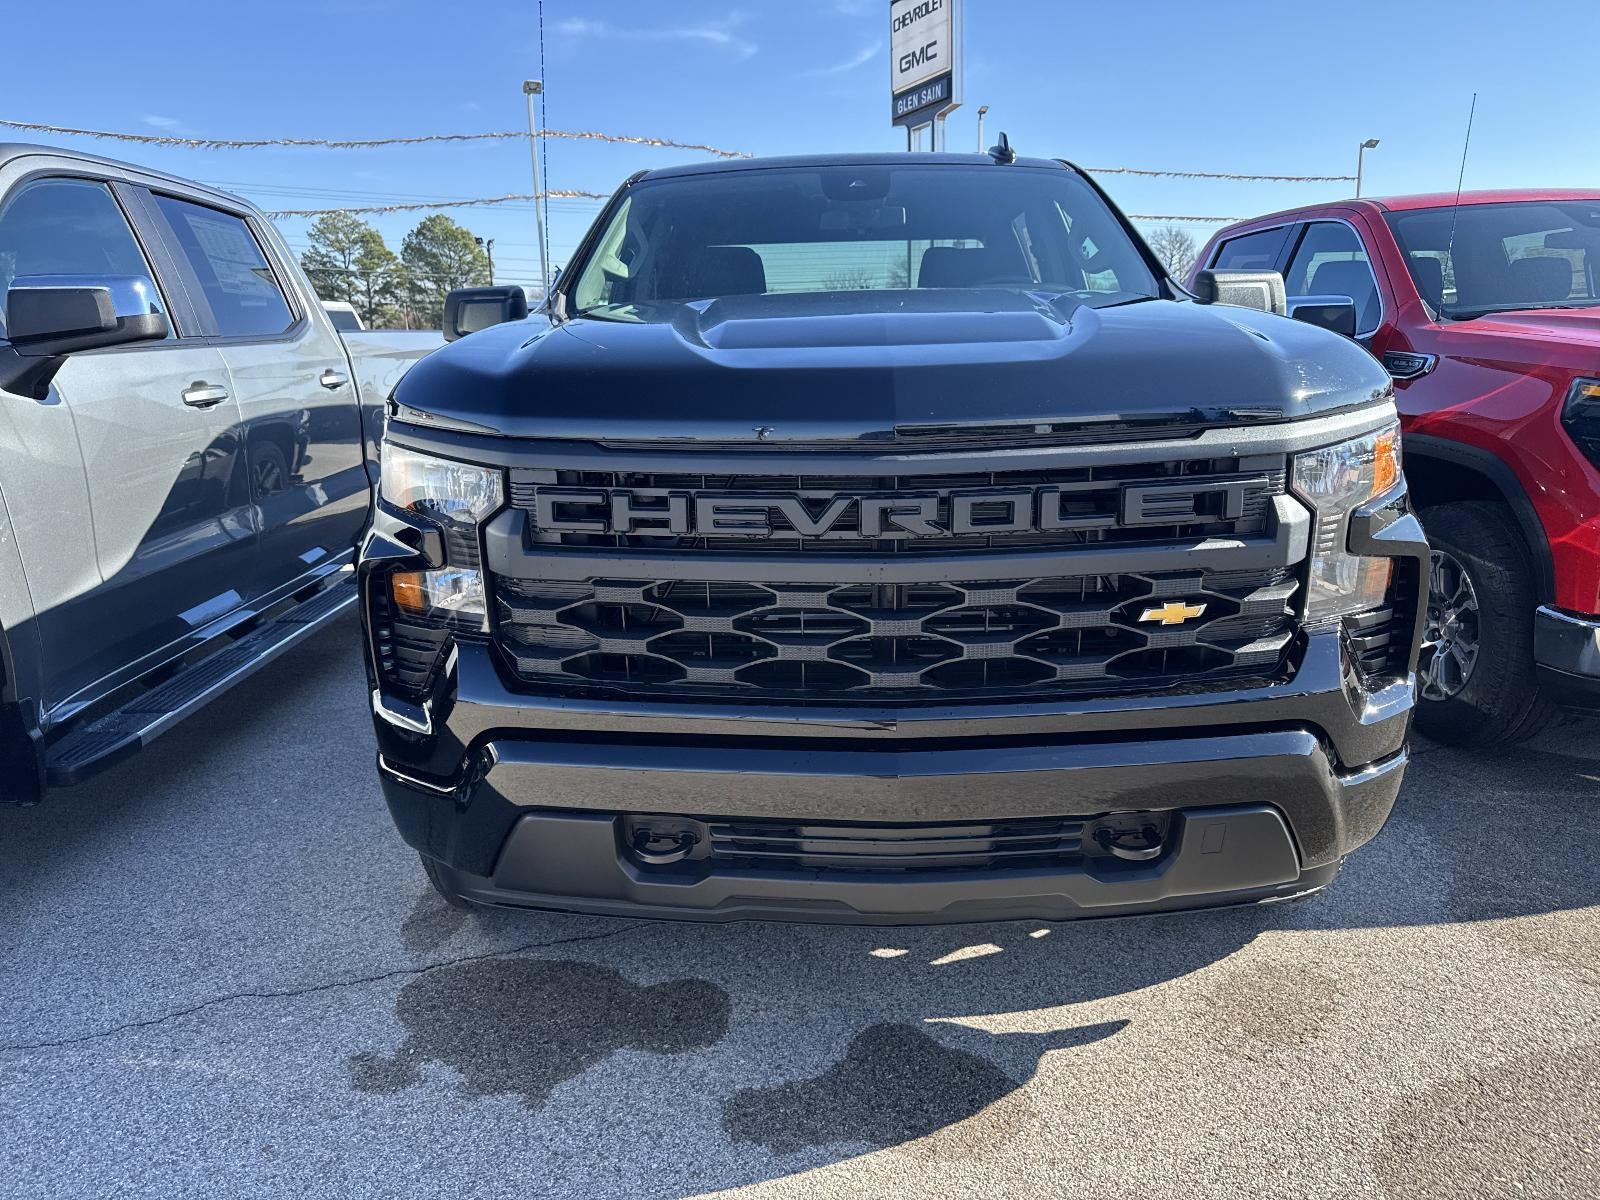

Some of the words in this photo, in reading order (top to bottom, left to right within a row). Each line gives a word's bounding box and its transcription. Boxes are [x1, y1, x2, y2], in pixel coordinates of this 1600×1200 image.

[900, 40, 937, 73] GMC
[897, 93, 919, 114] GLEN
[921, 84, 942, 106] SAIN
[535, 476, 1268, 540] CHEVROLET
